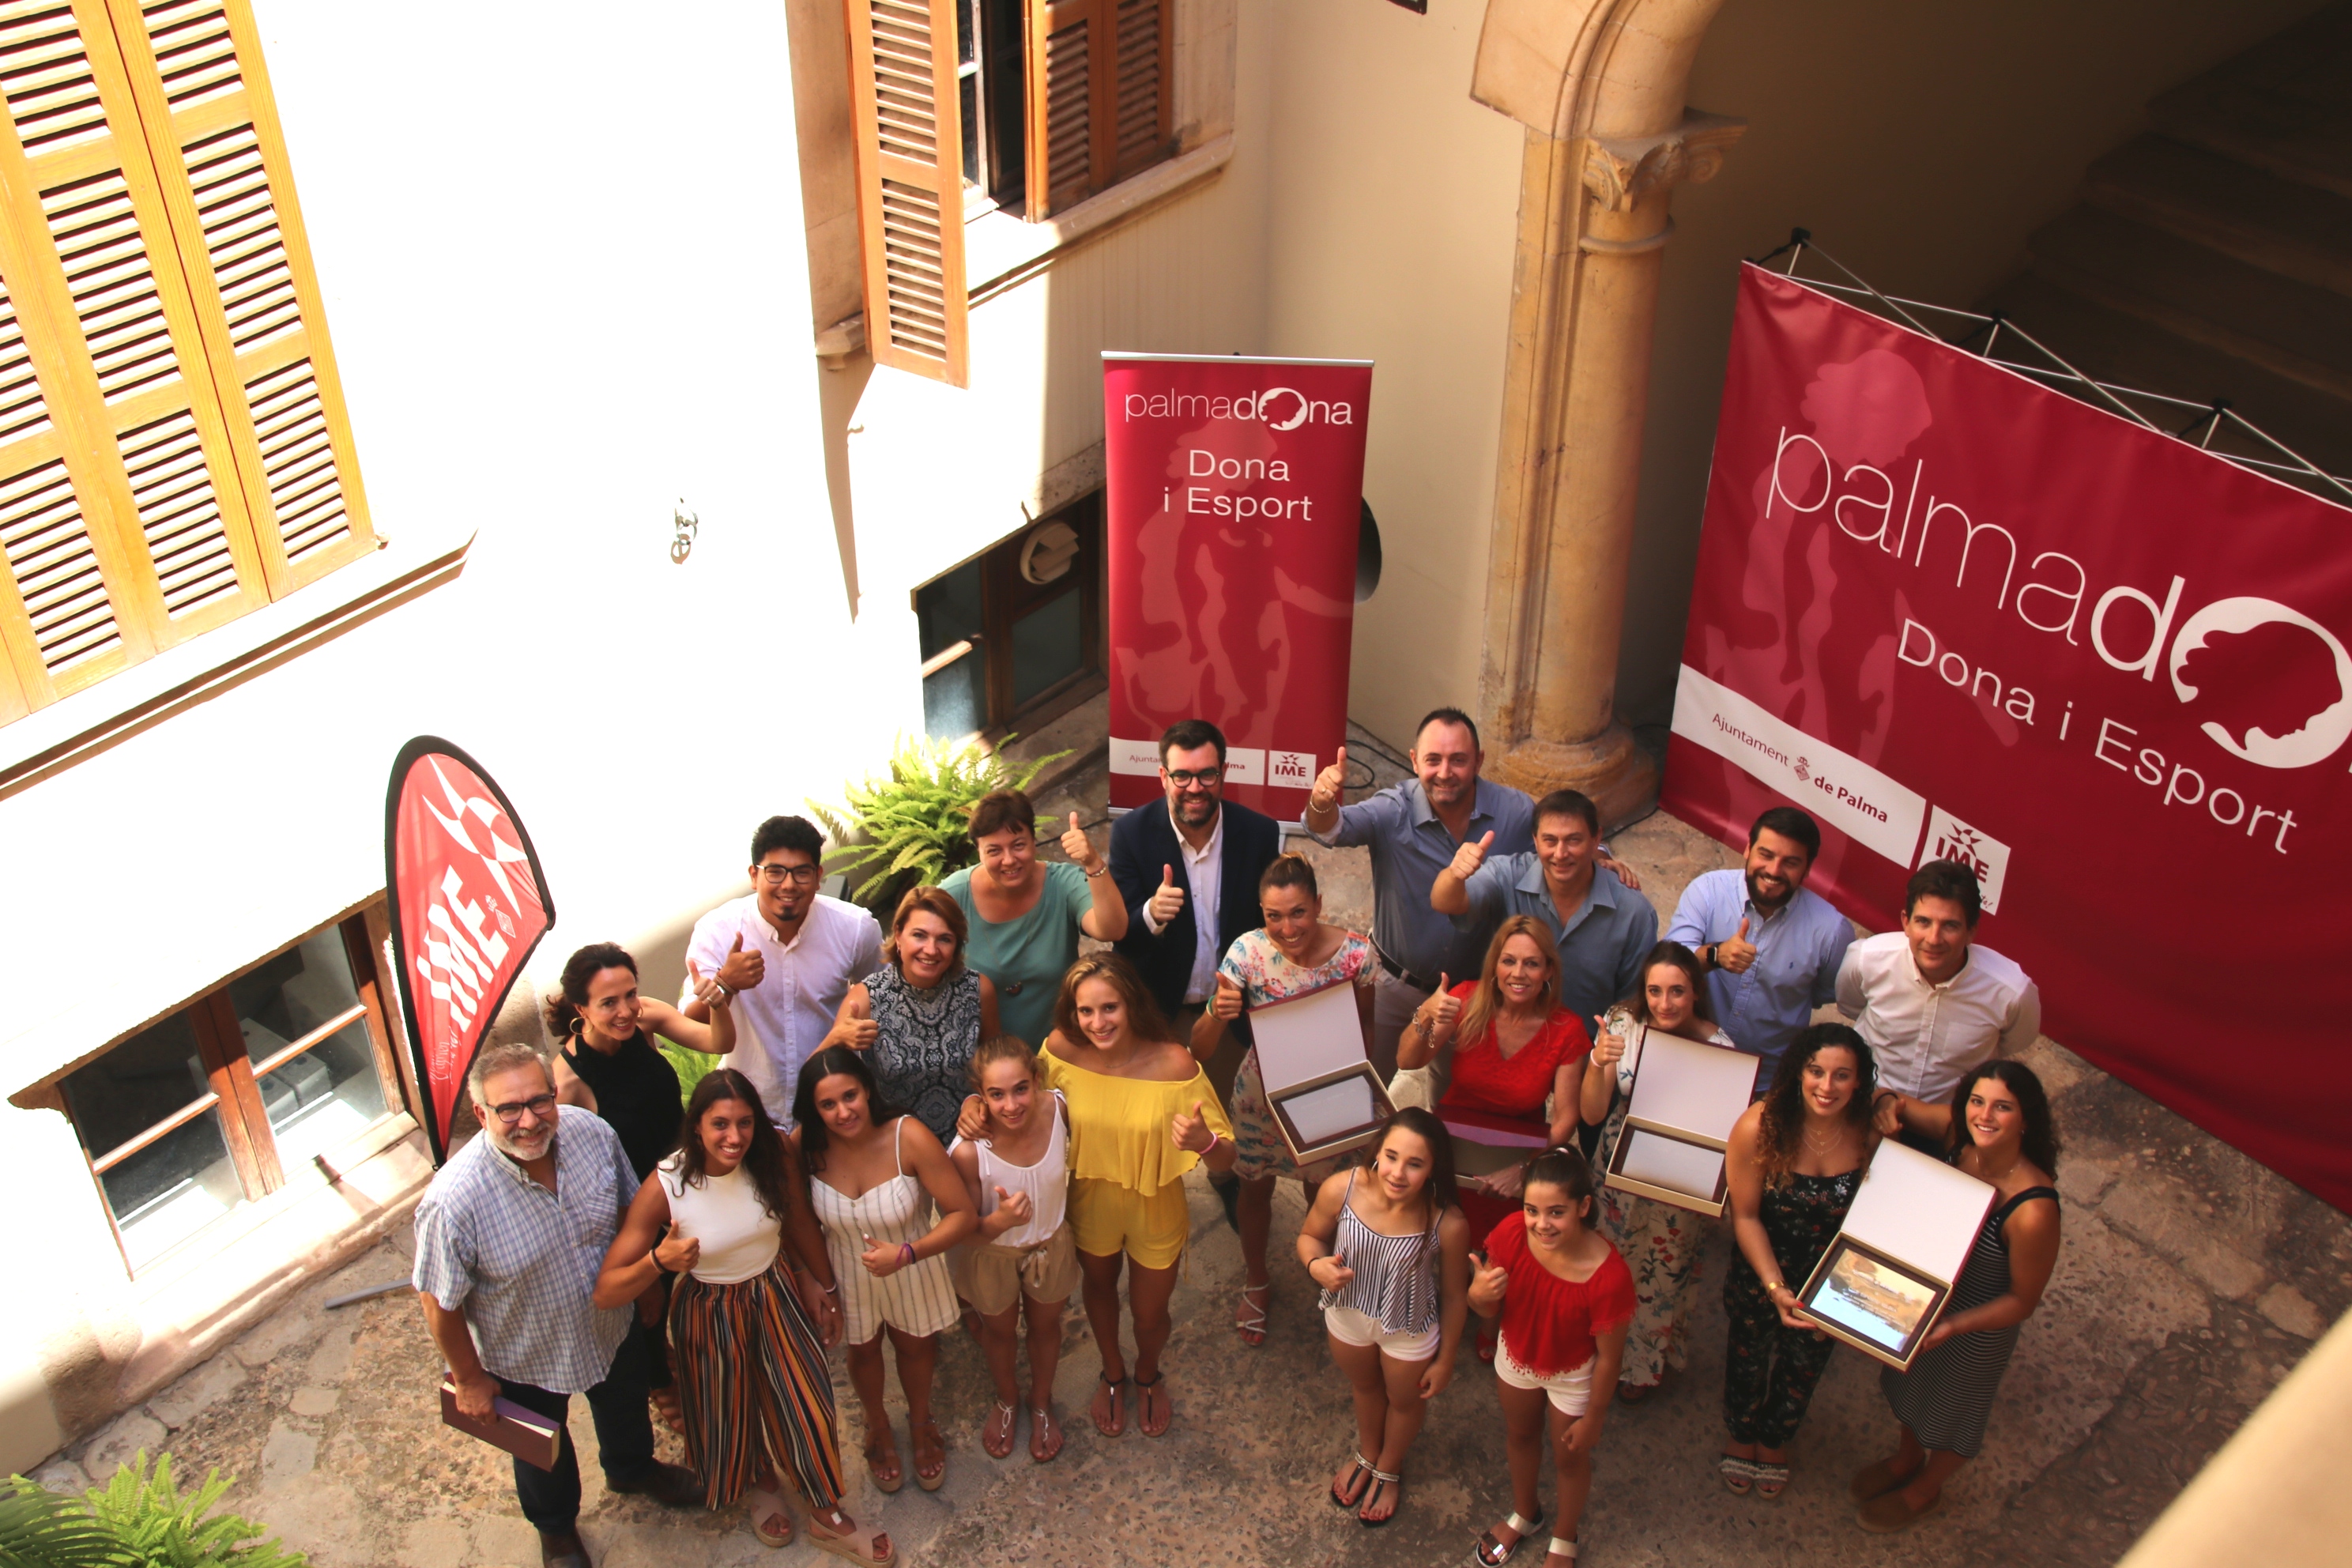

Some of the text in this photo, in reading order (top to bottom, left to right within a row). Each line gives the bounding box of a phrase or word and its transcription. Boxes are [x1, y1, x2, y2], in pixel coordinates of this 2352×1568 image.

[1189, 450, 1291, 481] Dona
[1163, 487, 1313, 522] i Esport
[1897, 618, 2297, 854] Dona i Esport
[1129, 755, 1162, 763] Ajunta
[1275, 764, 1306, 777] IME
[1712, 713, 1887, 823] Ajuntament de Palma
[1935, 836, 1989, 884] IME
[416, 864, 510, 1034] IME
